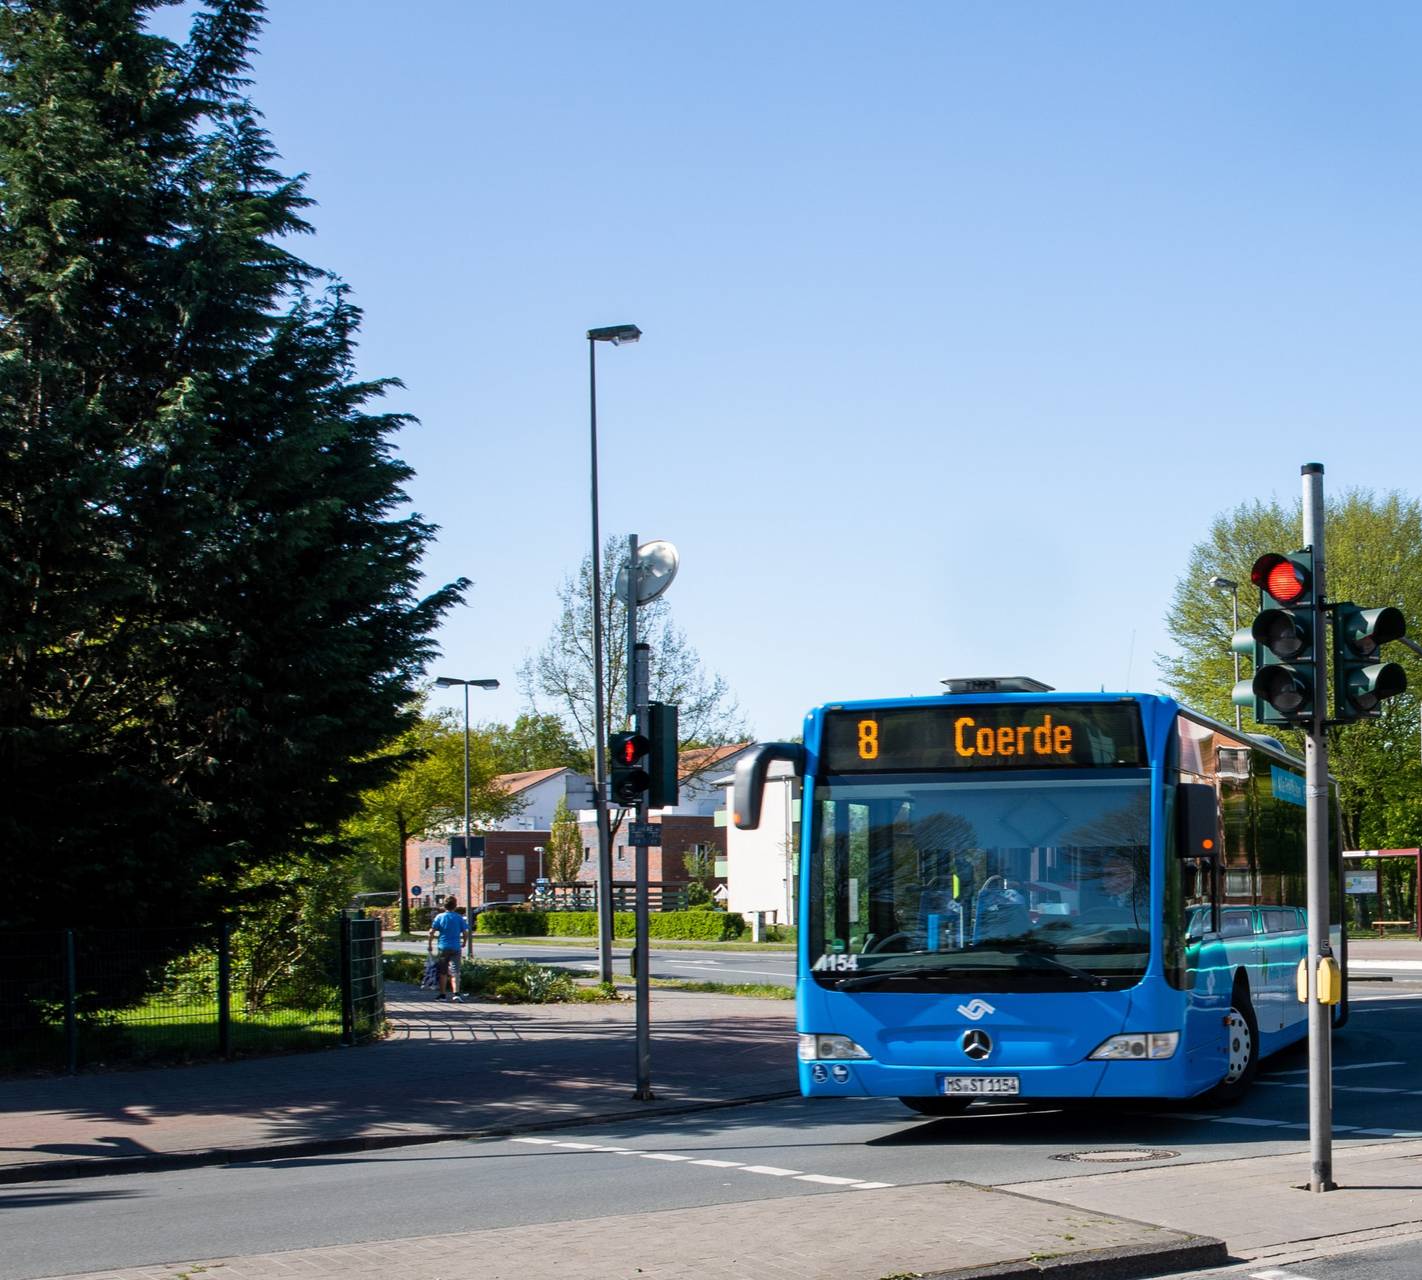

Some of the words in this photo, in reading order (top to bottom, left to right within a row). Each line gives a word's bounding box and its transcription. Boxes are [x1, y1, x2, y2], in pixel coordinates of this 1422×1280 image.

[857, 719, 879, 760] 8
[954, 714, 1072, 757] Coerde
[970, 1078, 985, 1092] ST
[987, 1078, 1017, 1092] 1154
